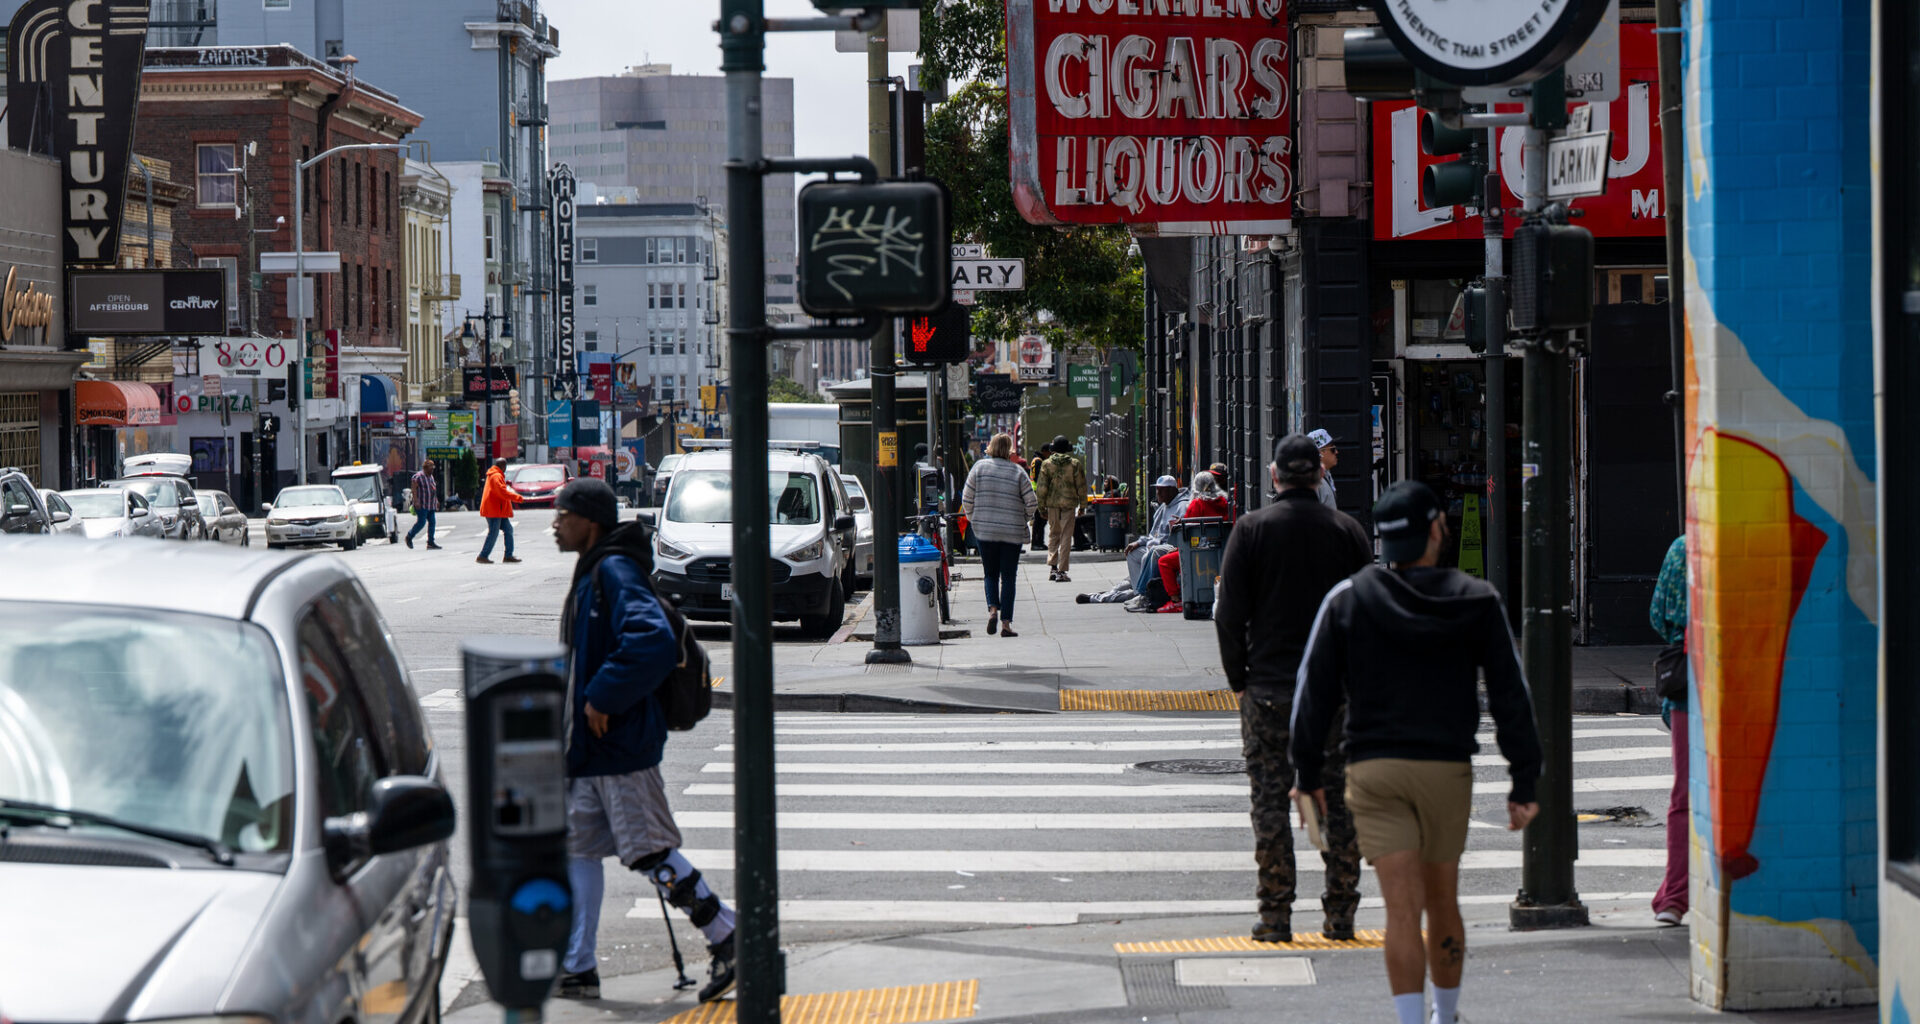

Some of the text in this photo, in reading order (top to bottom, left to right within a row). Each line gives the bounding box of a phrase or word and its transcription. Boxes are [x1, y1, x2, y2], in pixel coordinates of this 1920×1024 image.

[1398, 0, 1543, 57] THENTIC THAI STREET
[1044, 33, 1288, 119] CIGARS
[66, 0, 110, 260] CENTURY
[1055, 135, 1292, 215] LIQUORS
[1551, 147, 1599, 186] LARKIN
[560, 180, 572, 282] HOTEL
[952, 247, 966, 257] 00
[952, 266, 1016, 284] ARY
[89, 303, 149, 311] AFTERHOURS
[107, 294, 131, 302] OPEN
[169, 300, 219, 309] CENTURY
[561, 296, 574, 398] ESSEX
[80, 408, 127, 420] SMOKESHOP
